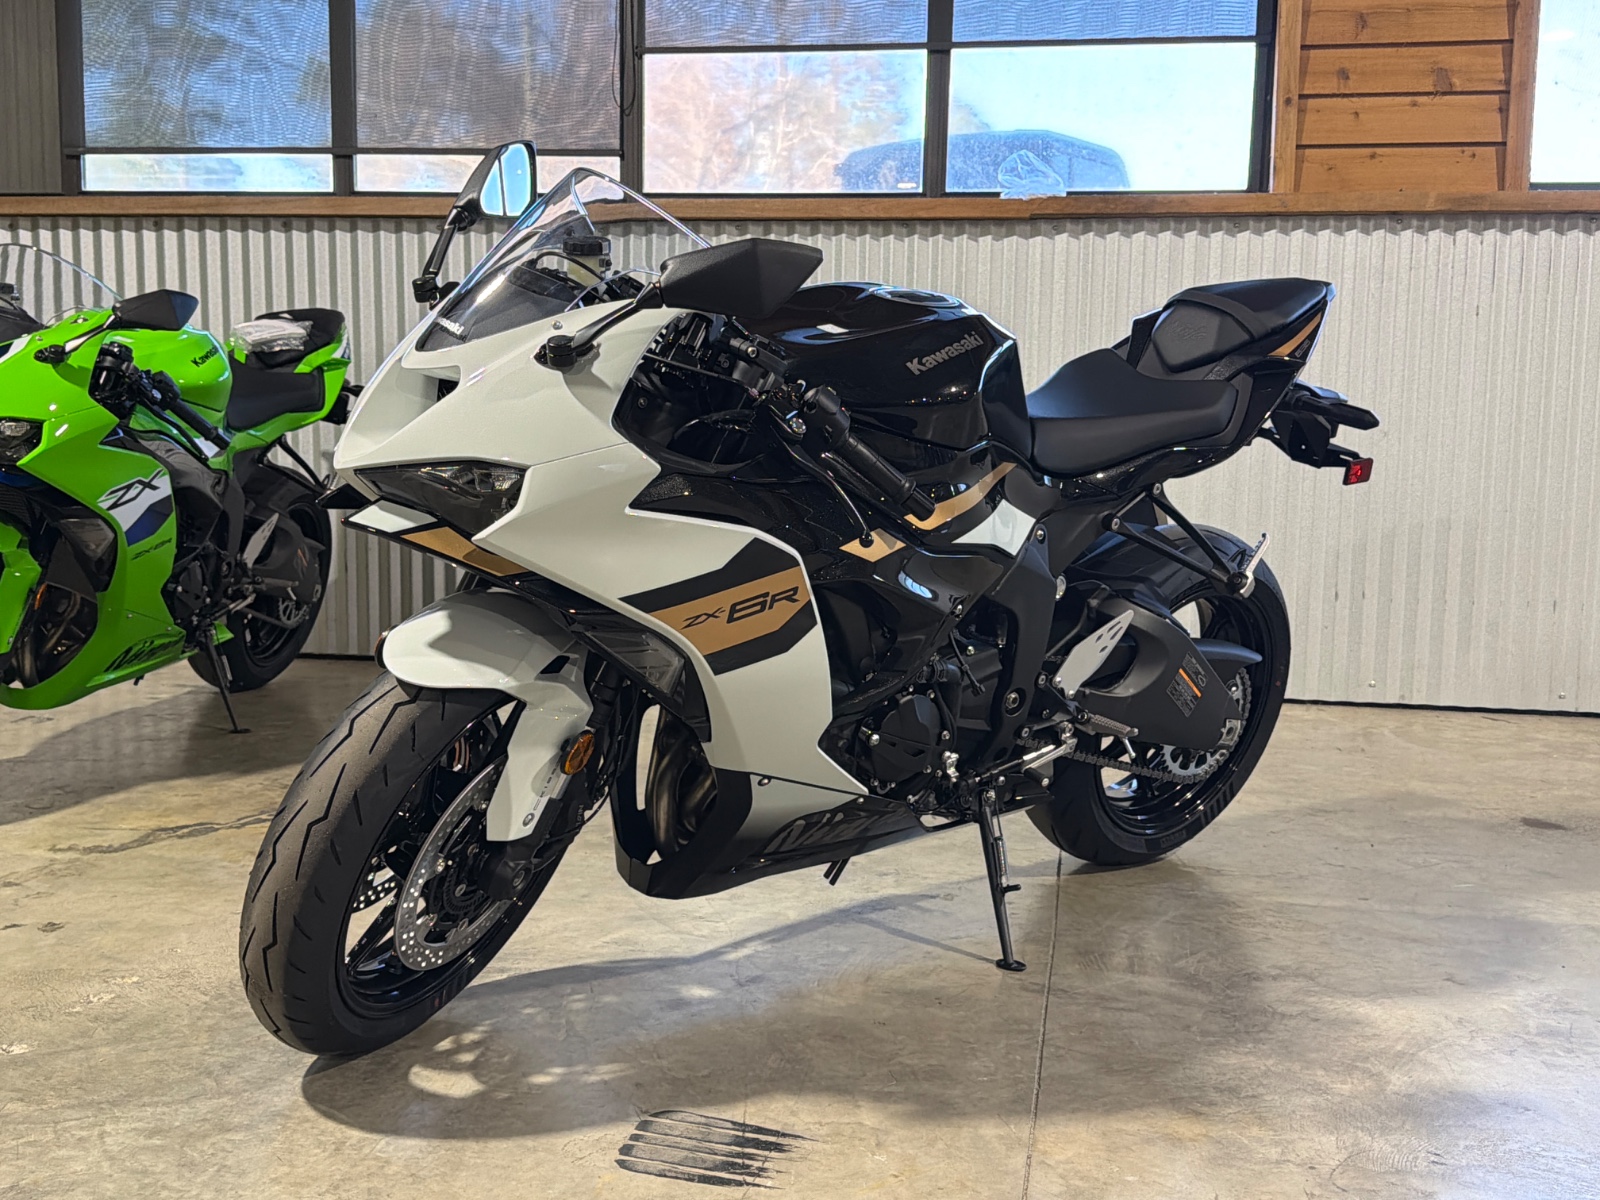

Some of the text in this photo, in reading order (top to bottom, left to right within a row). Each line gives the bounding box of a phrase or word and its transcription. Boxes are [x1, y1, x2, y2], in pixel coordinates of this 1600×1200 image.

[435, 316, 465, 335] asaki
[190, 345, 219, 368] Kawas
[905, 330, 984, 376] Kawasaki
[104, 468, 164, 512] ZX
[681, 585, 801, 630] ZX-6R
